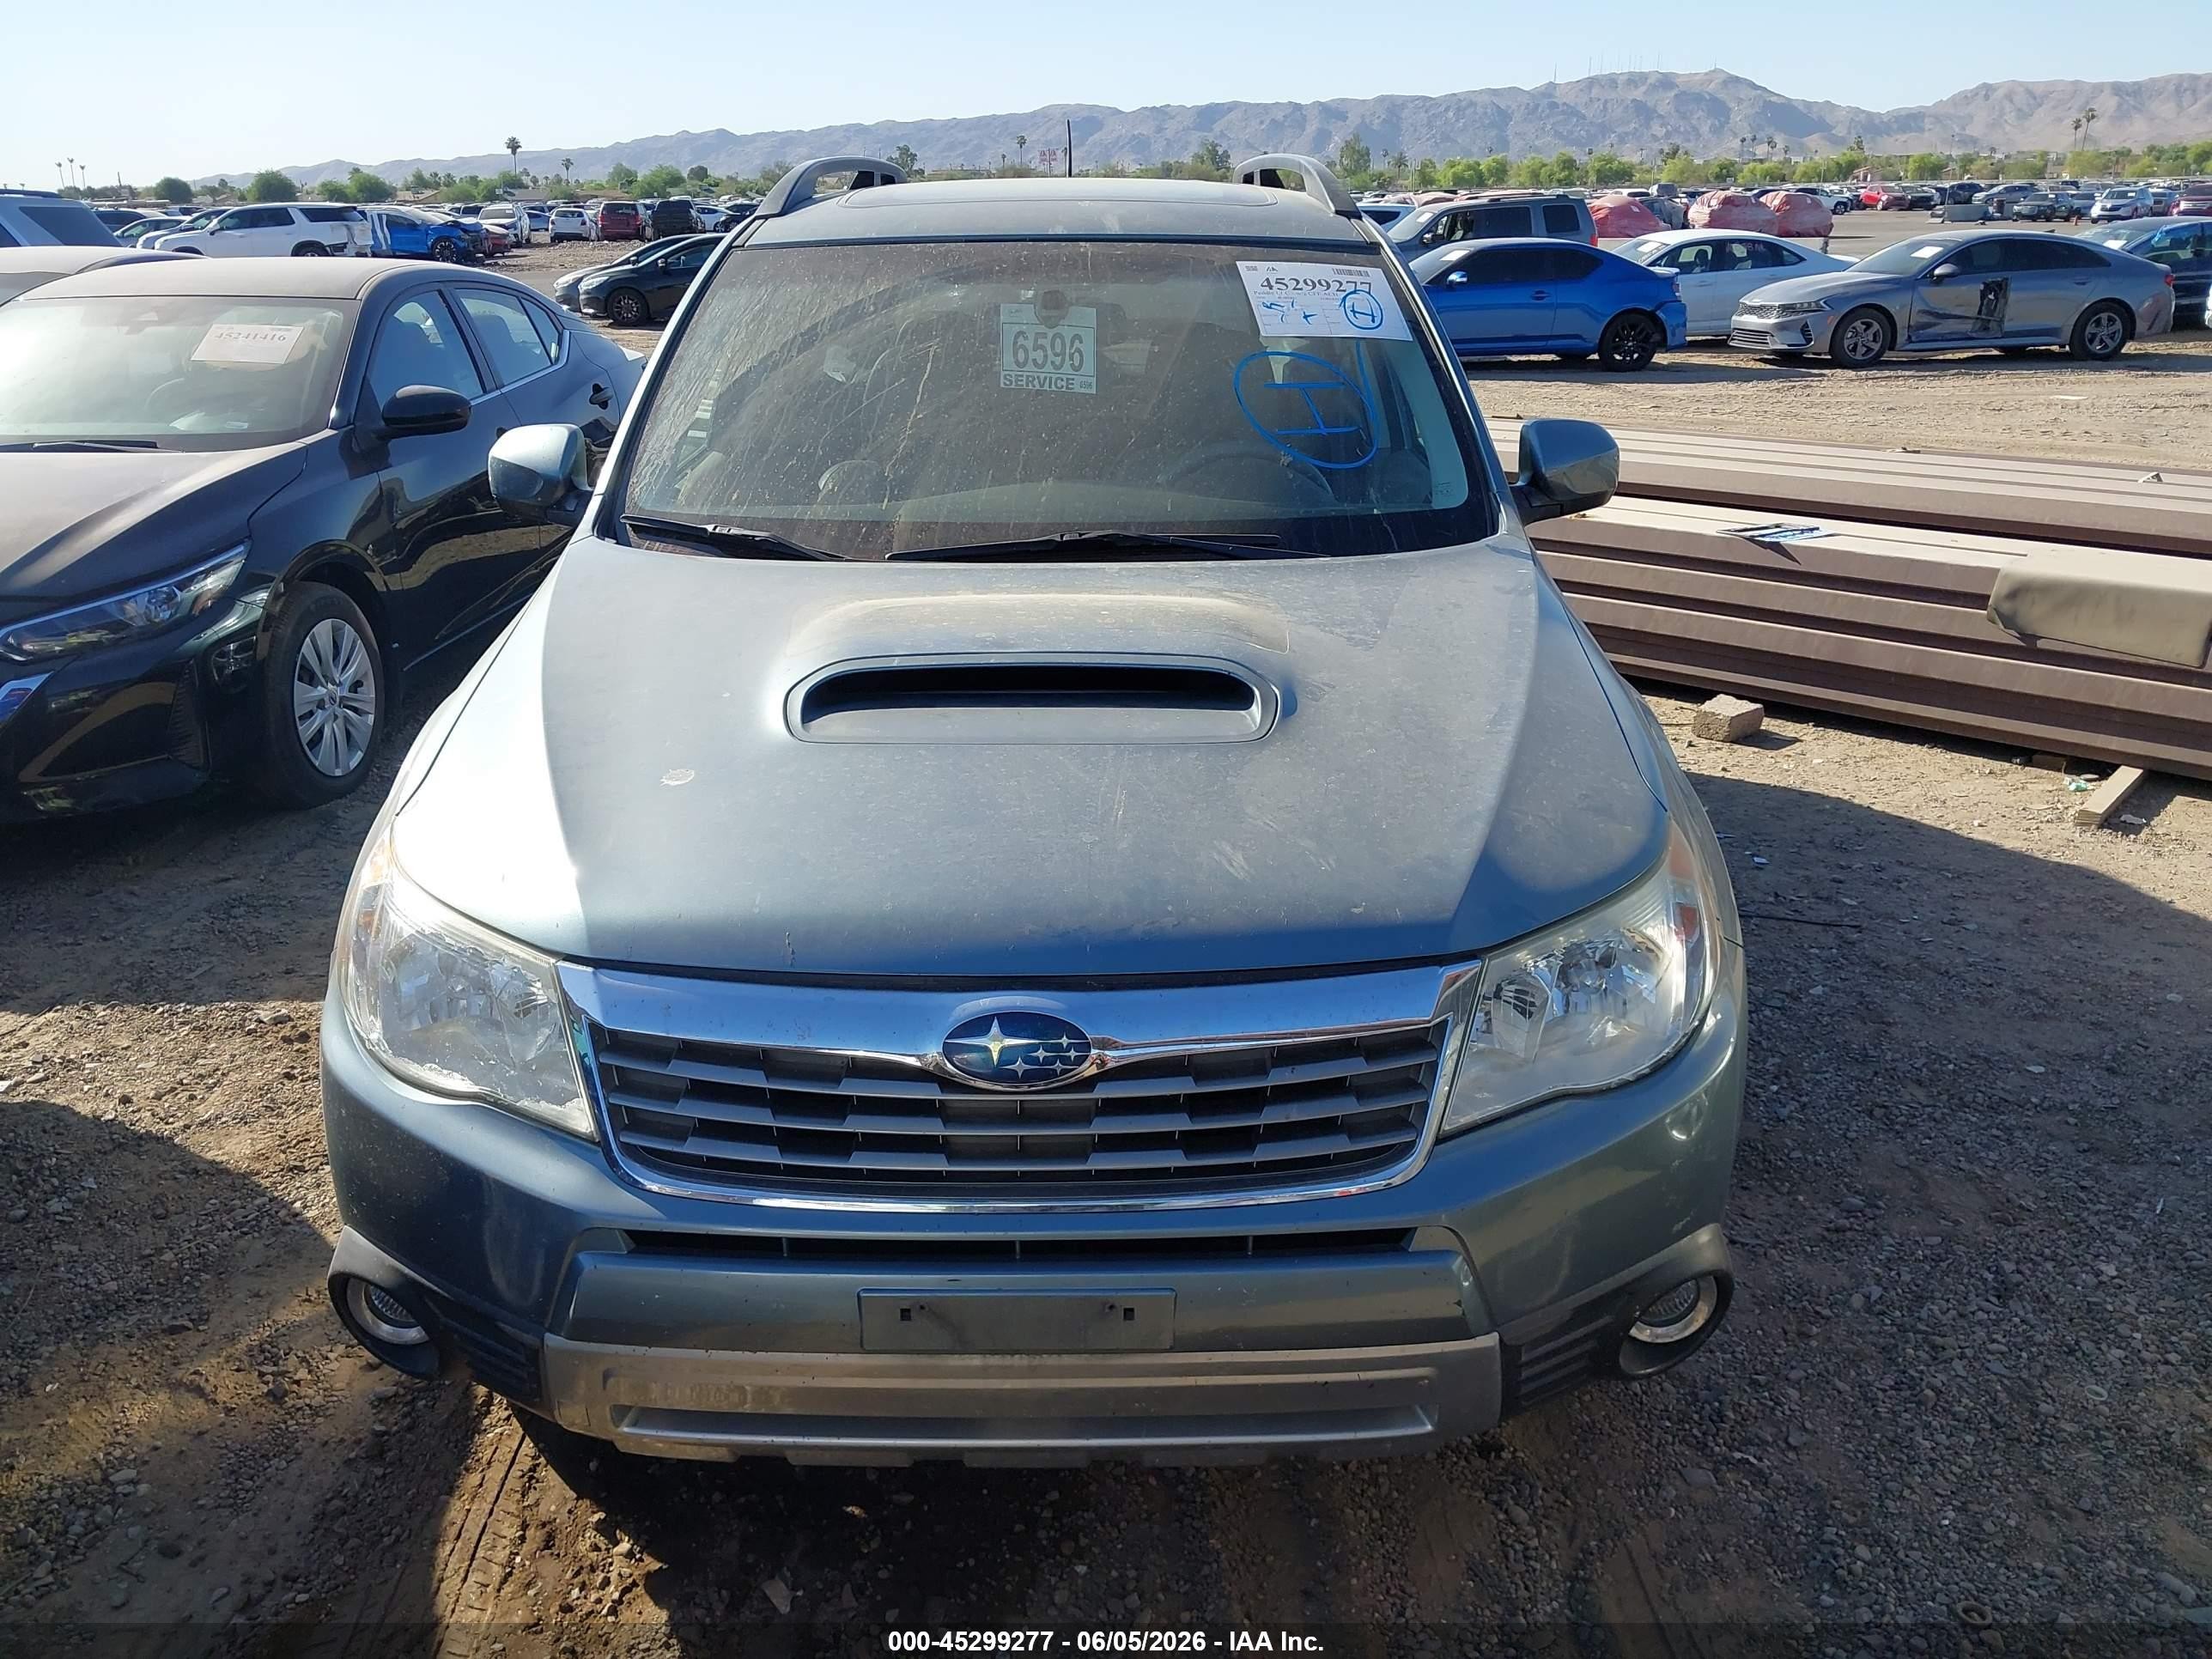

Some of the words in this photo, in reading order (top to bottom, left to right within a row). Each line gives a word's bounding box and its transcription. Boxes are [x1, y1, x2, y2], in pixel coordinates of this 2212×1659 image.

[1260, 277, 1372, 295] 45299277
[1012, 331, 1085, 372] 6596
[1003, 374, 1075, 390] SERVICE
